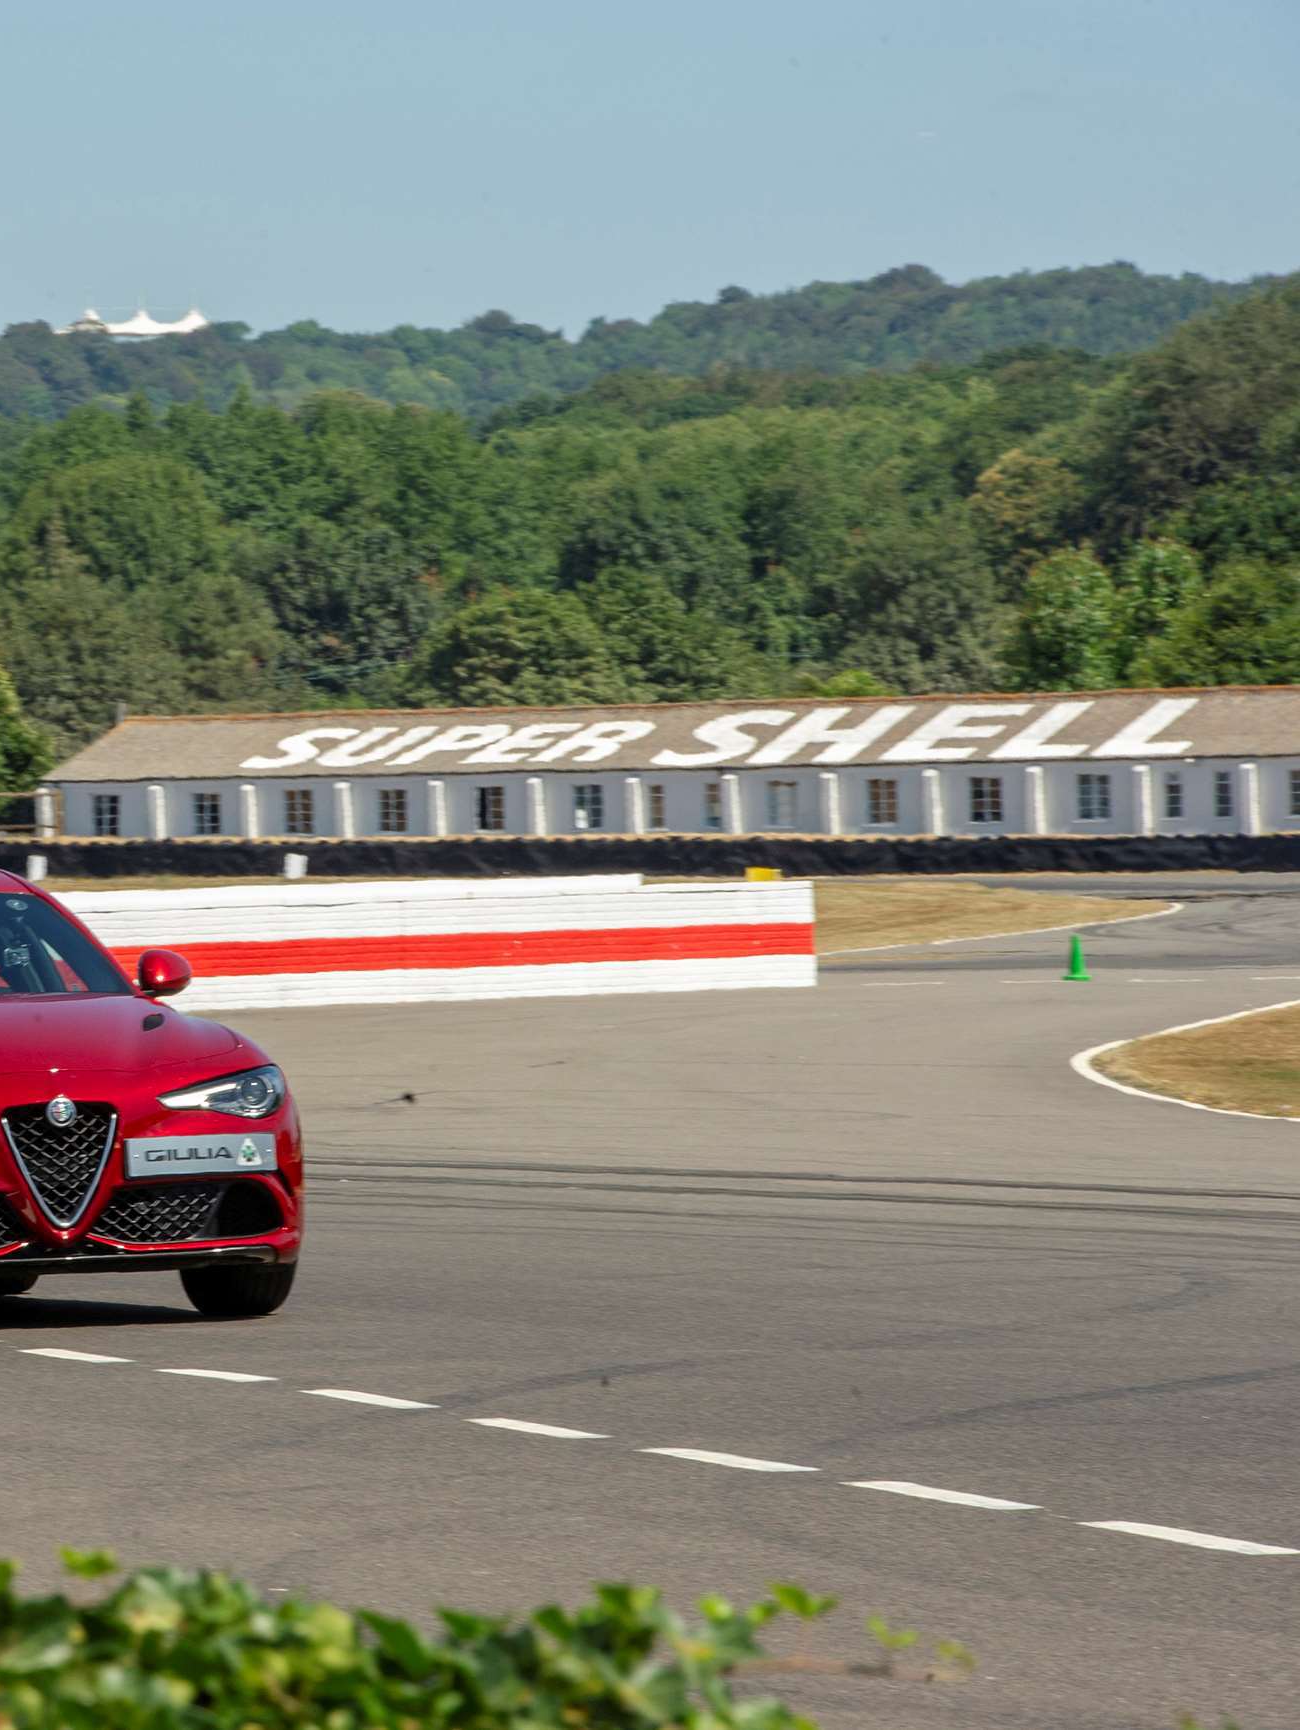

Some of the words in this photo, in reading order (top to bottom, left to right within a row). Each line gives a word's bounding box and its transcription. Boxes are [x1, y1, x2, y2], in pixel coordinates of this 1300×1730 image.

[239, 720, 657, 768] SUPER
[650, 698, 1199, 767] SHELL
[144, 1146, 233, 1162] GIULIA
